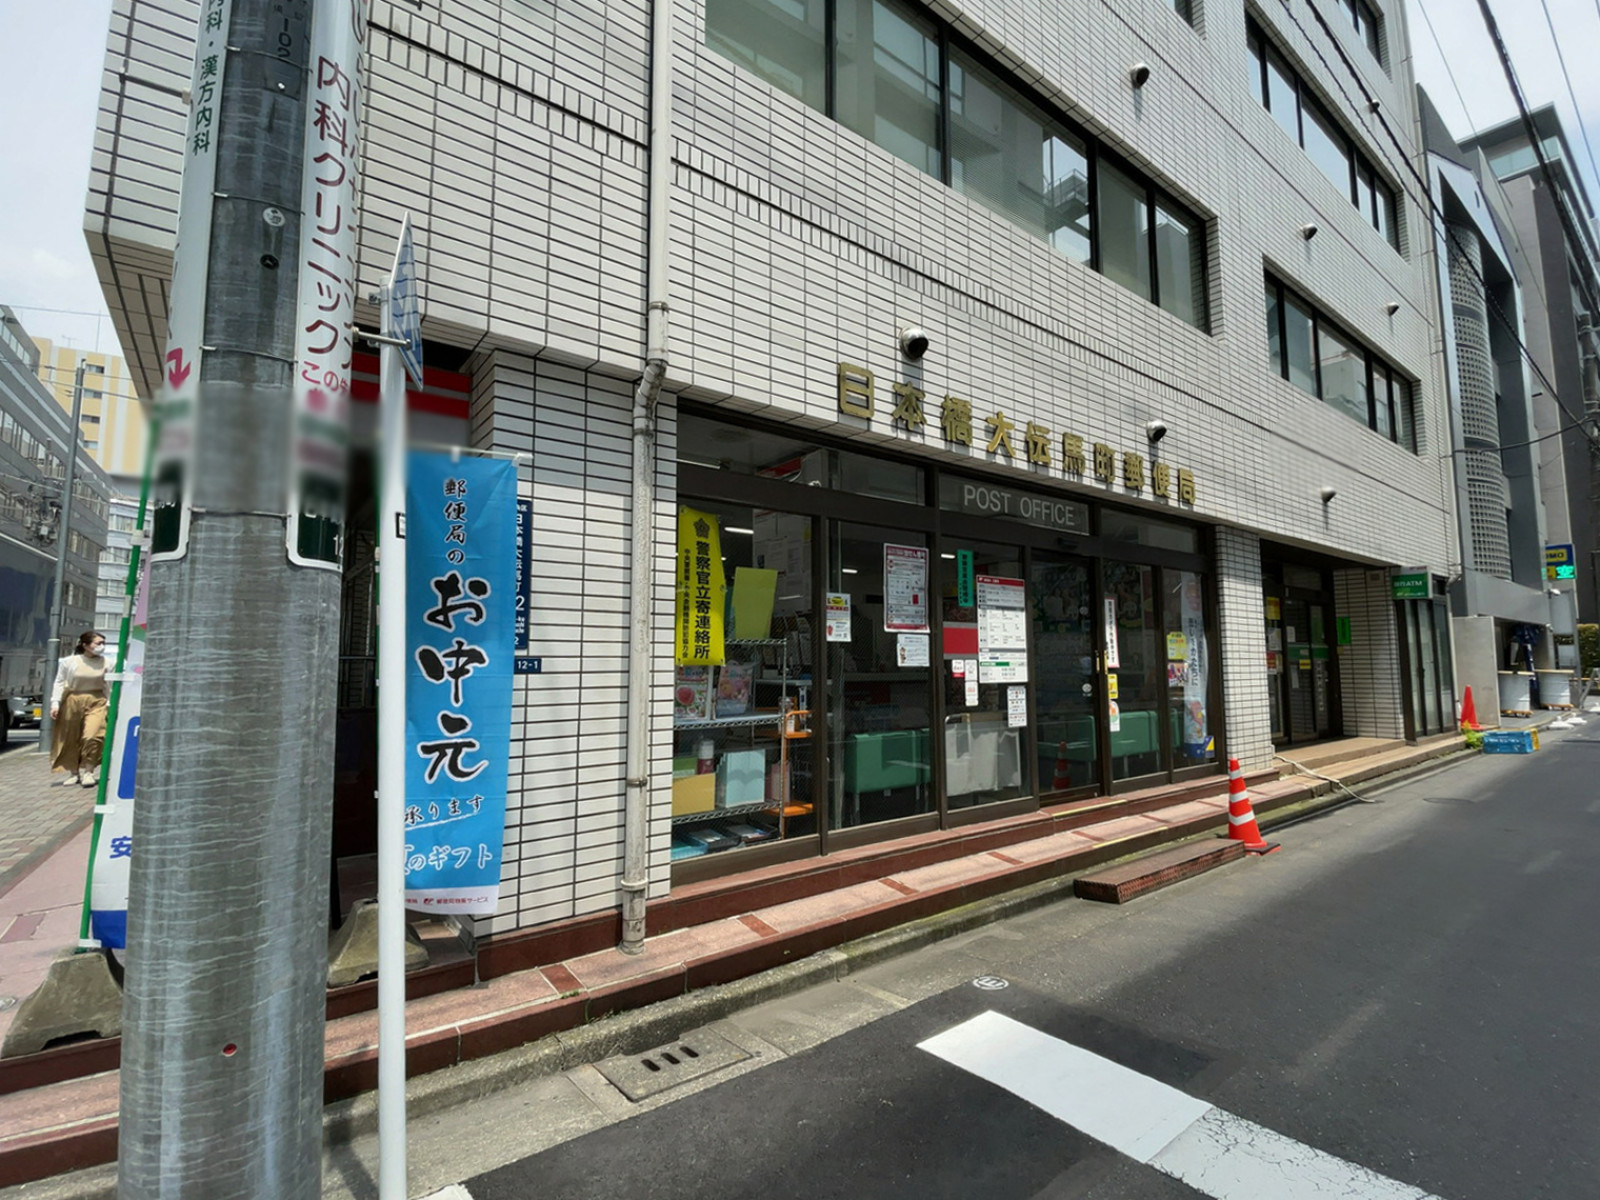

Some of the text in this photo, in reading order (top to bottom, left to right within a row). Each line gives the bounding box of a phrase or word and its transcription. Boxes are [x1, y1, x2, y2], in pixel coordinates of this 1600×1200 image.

[305, 56, 350, 355] 内科クリニック
[838, 361, 1196, 505] 日本橋大伝馬町郵便局
[443, 477, 468, 565] 郵便局の
[963, 485, 1076, 527] POST OFFICE
[693, 541, 712, 660] 警察官立寄連絡所
[415, 569, 492, 784] お中元
[517, 659, 538, 670] 12-1
[404, 795, 484, 826] 承ります
